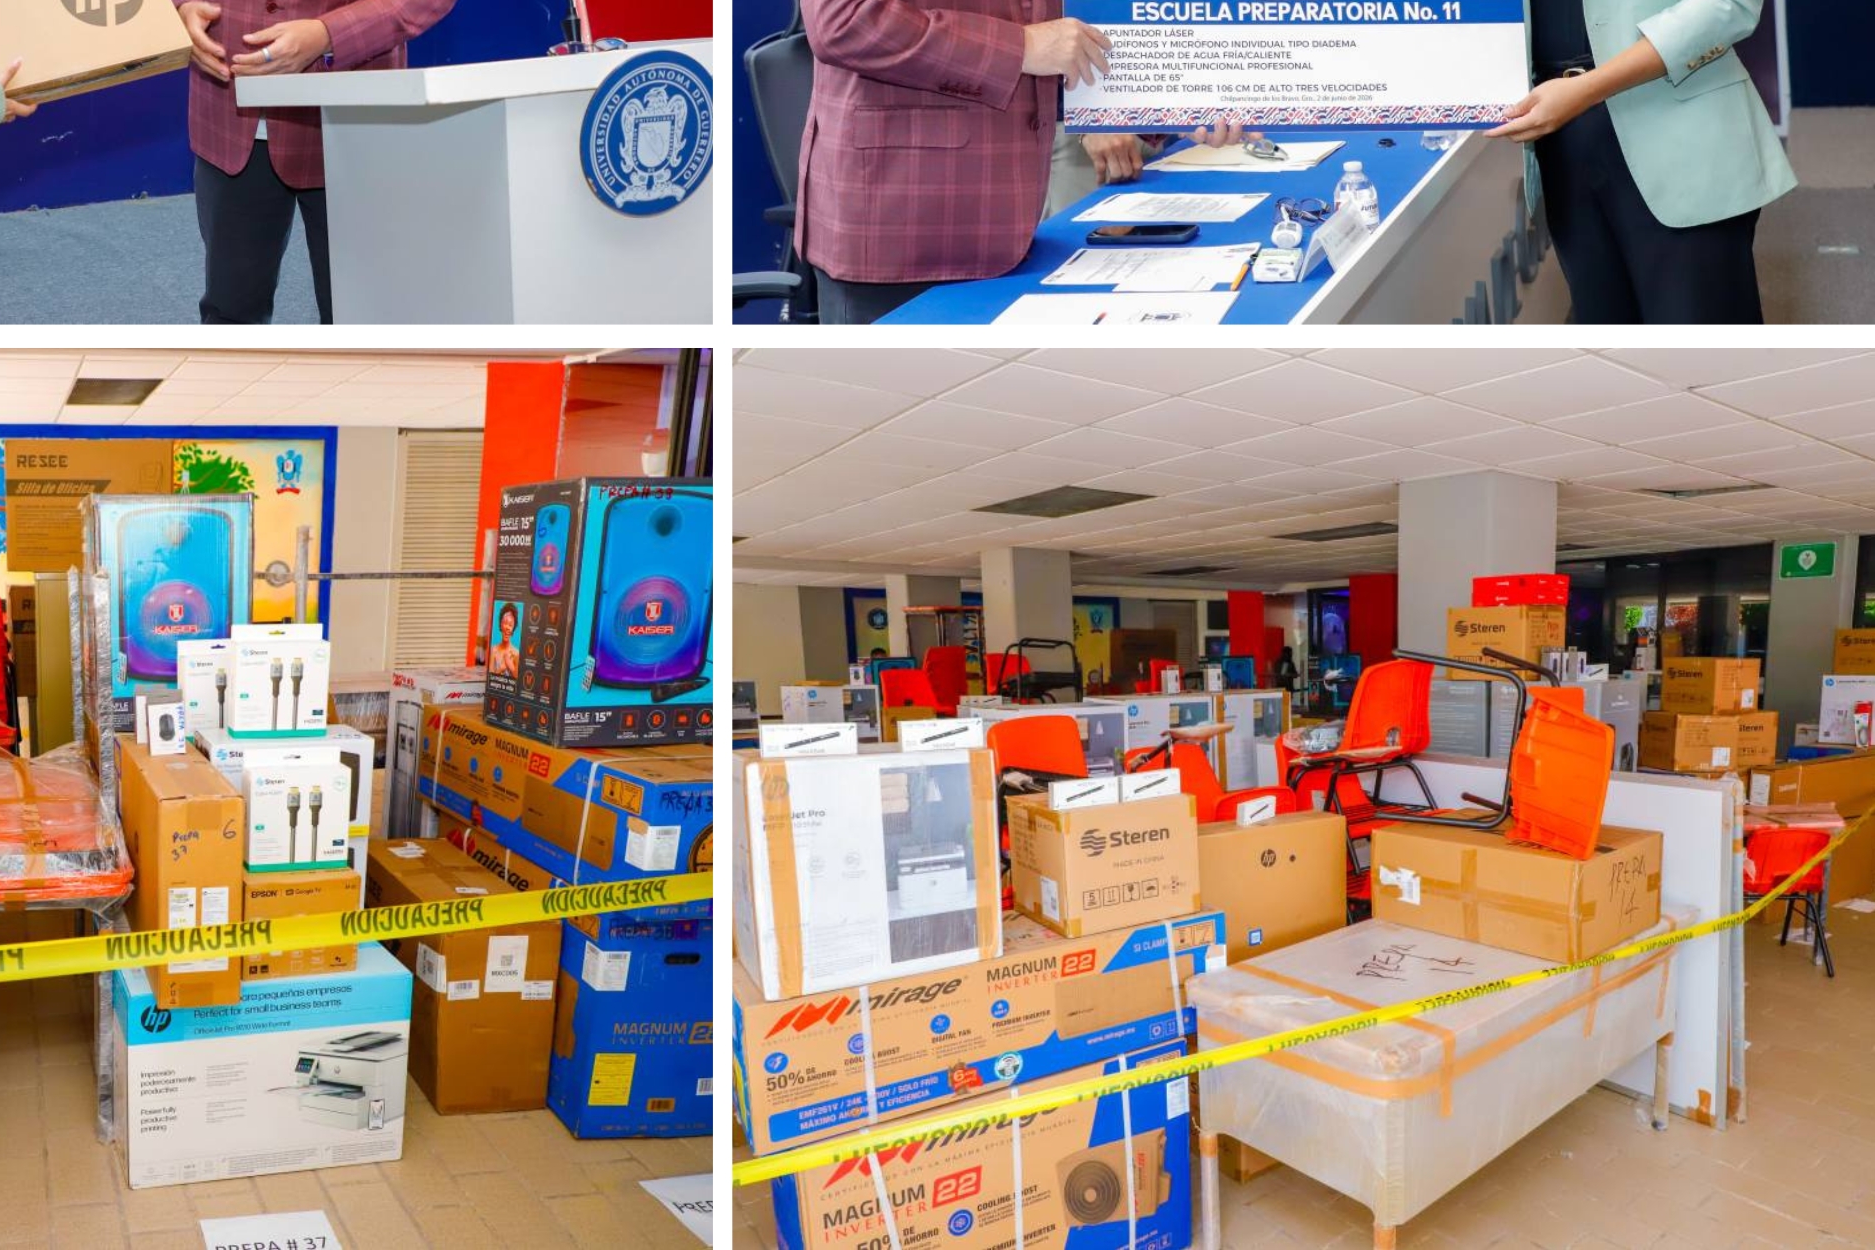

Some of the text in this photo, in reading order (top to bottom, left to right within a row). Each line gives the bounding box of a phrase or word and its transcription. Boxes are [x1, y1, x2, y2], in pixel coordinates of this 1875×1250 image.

[1132, 1, 1461, 22] ESCUELA PREPARATORIA No. 11
[1164, 28, 1194, 37] LÁSER
[1171, 39, 1228, 48] MICRÓFONO
[1231, 40, 1285, 48] INDIVIDUAL
[1312, 40, 1356, 48] DIADEMA
[1223, 50, 1291, 59] FRÍA/CALIENTE
[1162, 62, 1244, 71] MULTIFUNCIONAL
[1269, 84, 1293, 92] ALTO
[597, 69, 709, 186] UNIVERSIDAD AUTÓNOMA DE GUERRERO
[17, 455, 68, 467] RESEE
[628, 626, 673, 634] KAISER
[1470, 623, 1505, 633] Steren
[1677, 670, 1703, 678] Steren
[565, 713, 589, 721] BAFLE
[449, 721, 488, 745] mirage
[495, 738, 549, 774] MAGNUM 22
[1110, 828, 1170, 847] Steren
[251, 890, 277, 898] EPSON
[987, 953, 1093, 982] MAGNUM 22
[987, 972, 1058, 994] INVERTER
[306, 985, 352, 996] empresas
[194, 1008, 227, 1019] Perfect
[245, 1004, 269, 1014] small
[270, 1002, 310, 1012] business
[313, 999, 342, 1008] teams
[613, 1023, 686, 1035] MAGNUM
[767, 1070, 805, 1092] 50%
[938, 1171, 977, 1200] 22
[977, 1194, 1011, 1211] COOLING
[903, 1227, 939, 1244] DE AHORRO
[287, 1237, 326, 1250] # 37
